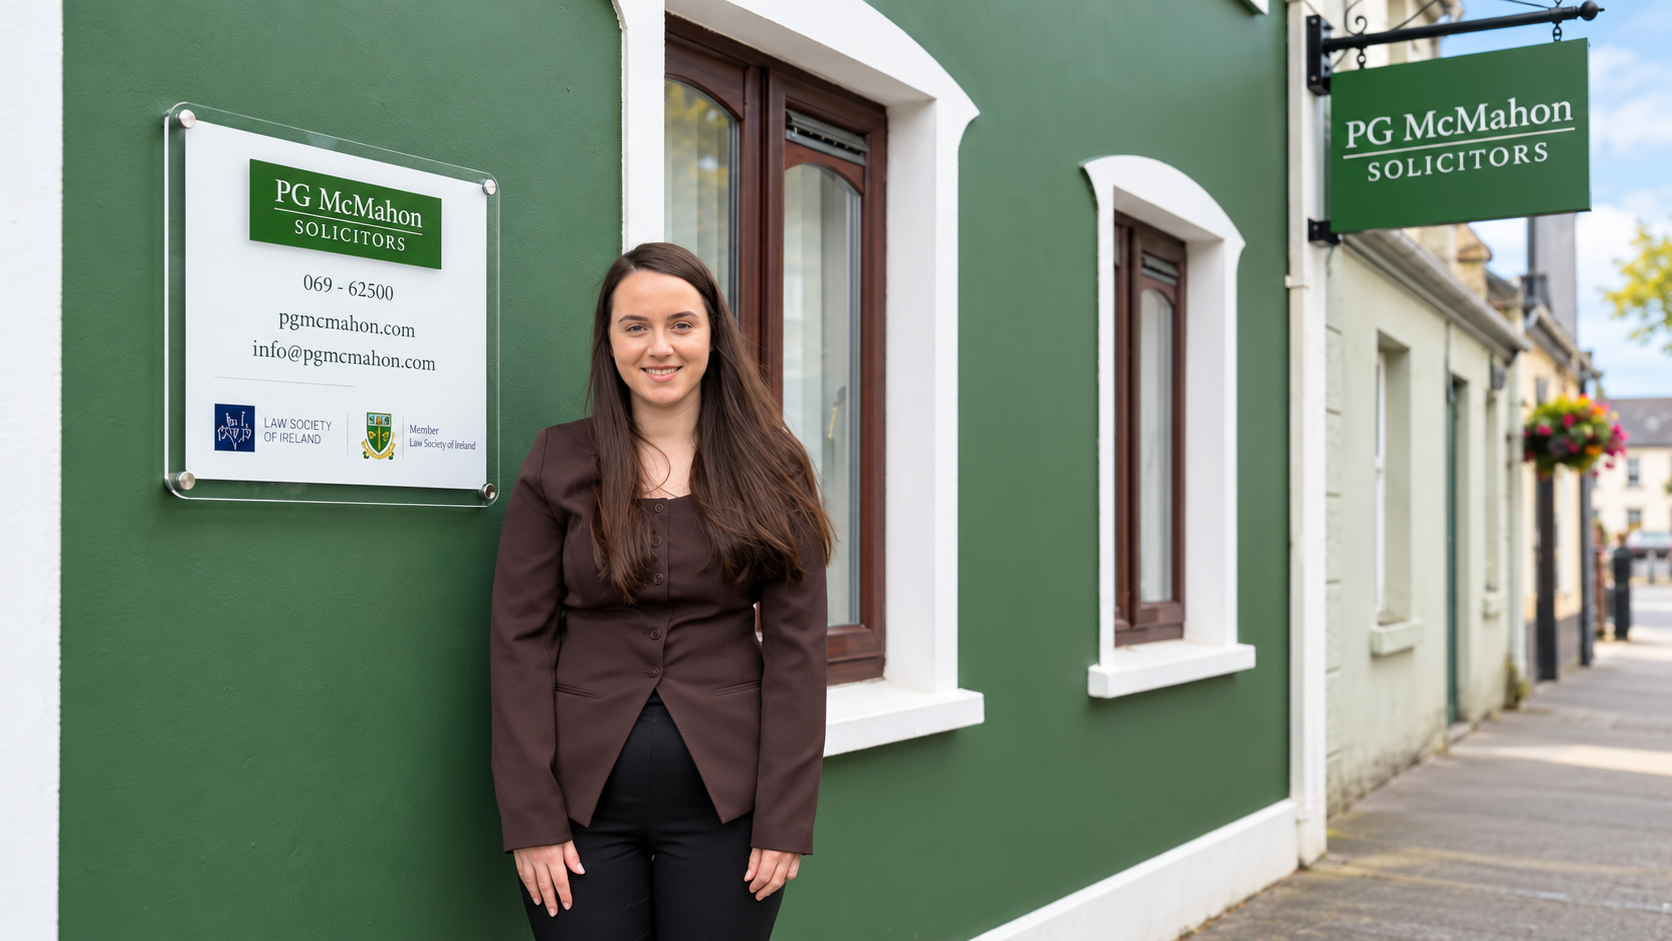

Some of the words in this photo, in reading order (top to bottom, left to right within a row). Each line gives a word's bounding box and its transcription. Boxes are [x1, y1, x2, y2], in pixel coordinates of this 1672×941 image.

[1345, 116, 1394, 149] PG
[1403, 97, 1573, 142] McMahon
[1367, 142, 1548, 182] SOLICITORS
[275, 179, 311, 207] PG
[318, 187, 423, 228] McMahon
[294, 219, 406, 252] SOLICITORS
[303, 274, 333, 293] 069
[348, 280, 394, 301] 62500
[278, 311, 415, 338] pgmcmahon.com
[252, 339, 436, 371] info@pgmcmahon.com
[263, 417, 287, 429] LAW
[289, 418, 333, 431] SOCIETY
[409, 424, 439, 435] Member
[263, 431, 277, 443] OF
[279, 432, 322, 445] IRELAND
[409, 437, 422, 447] Law
[423, 438, 446, 451] Society
[447, 440, 454, 449] of
